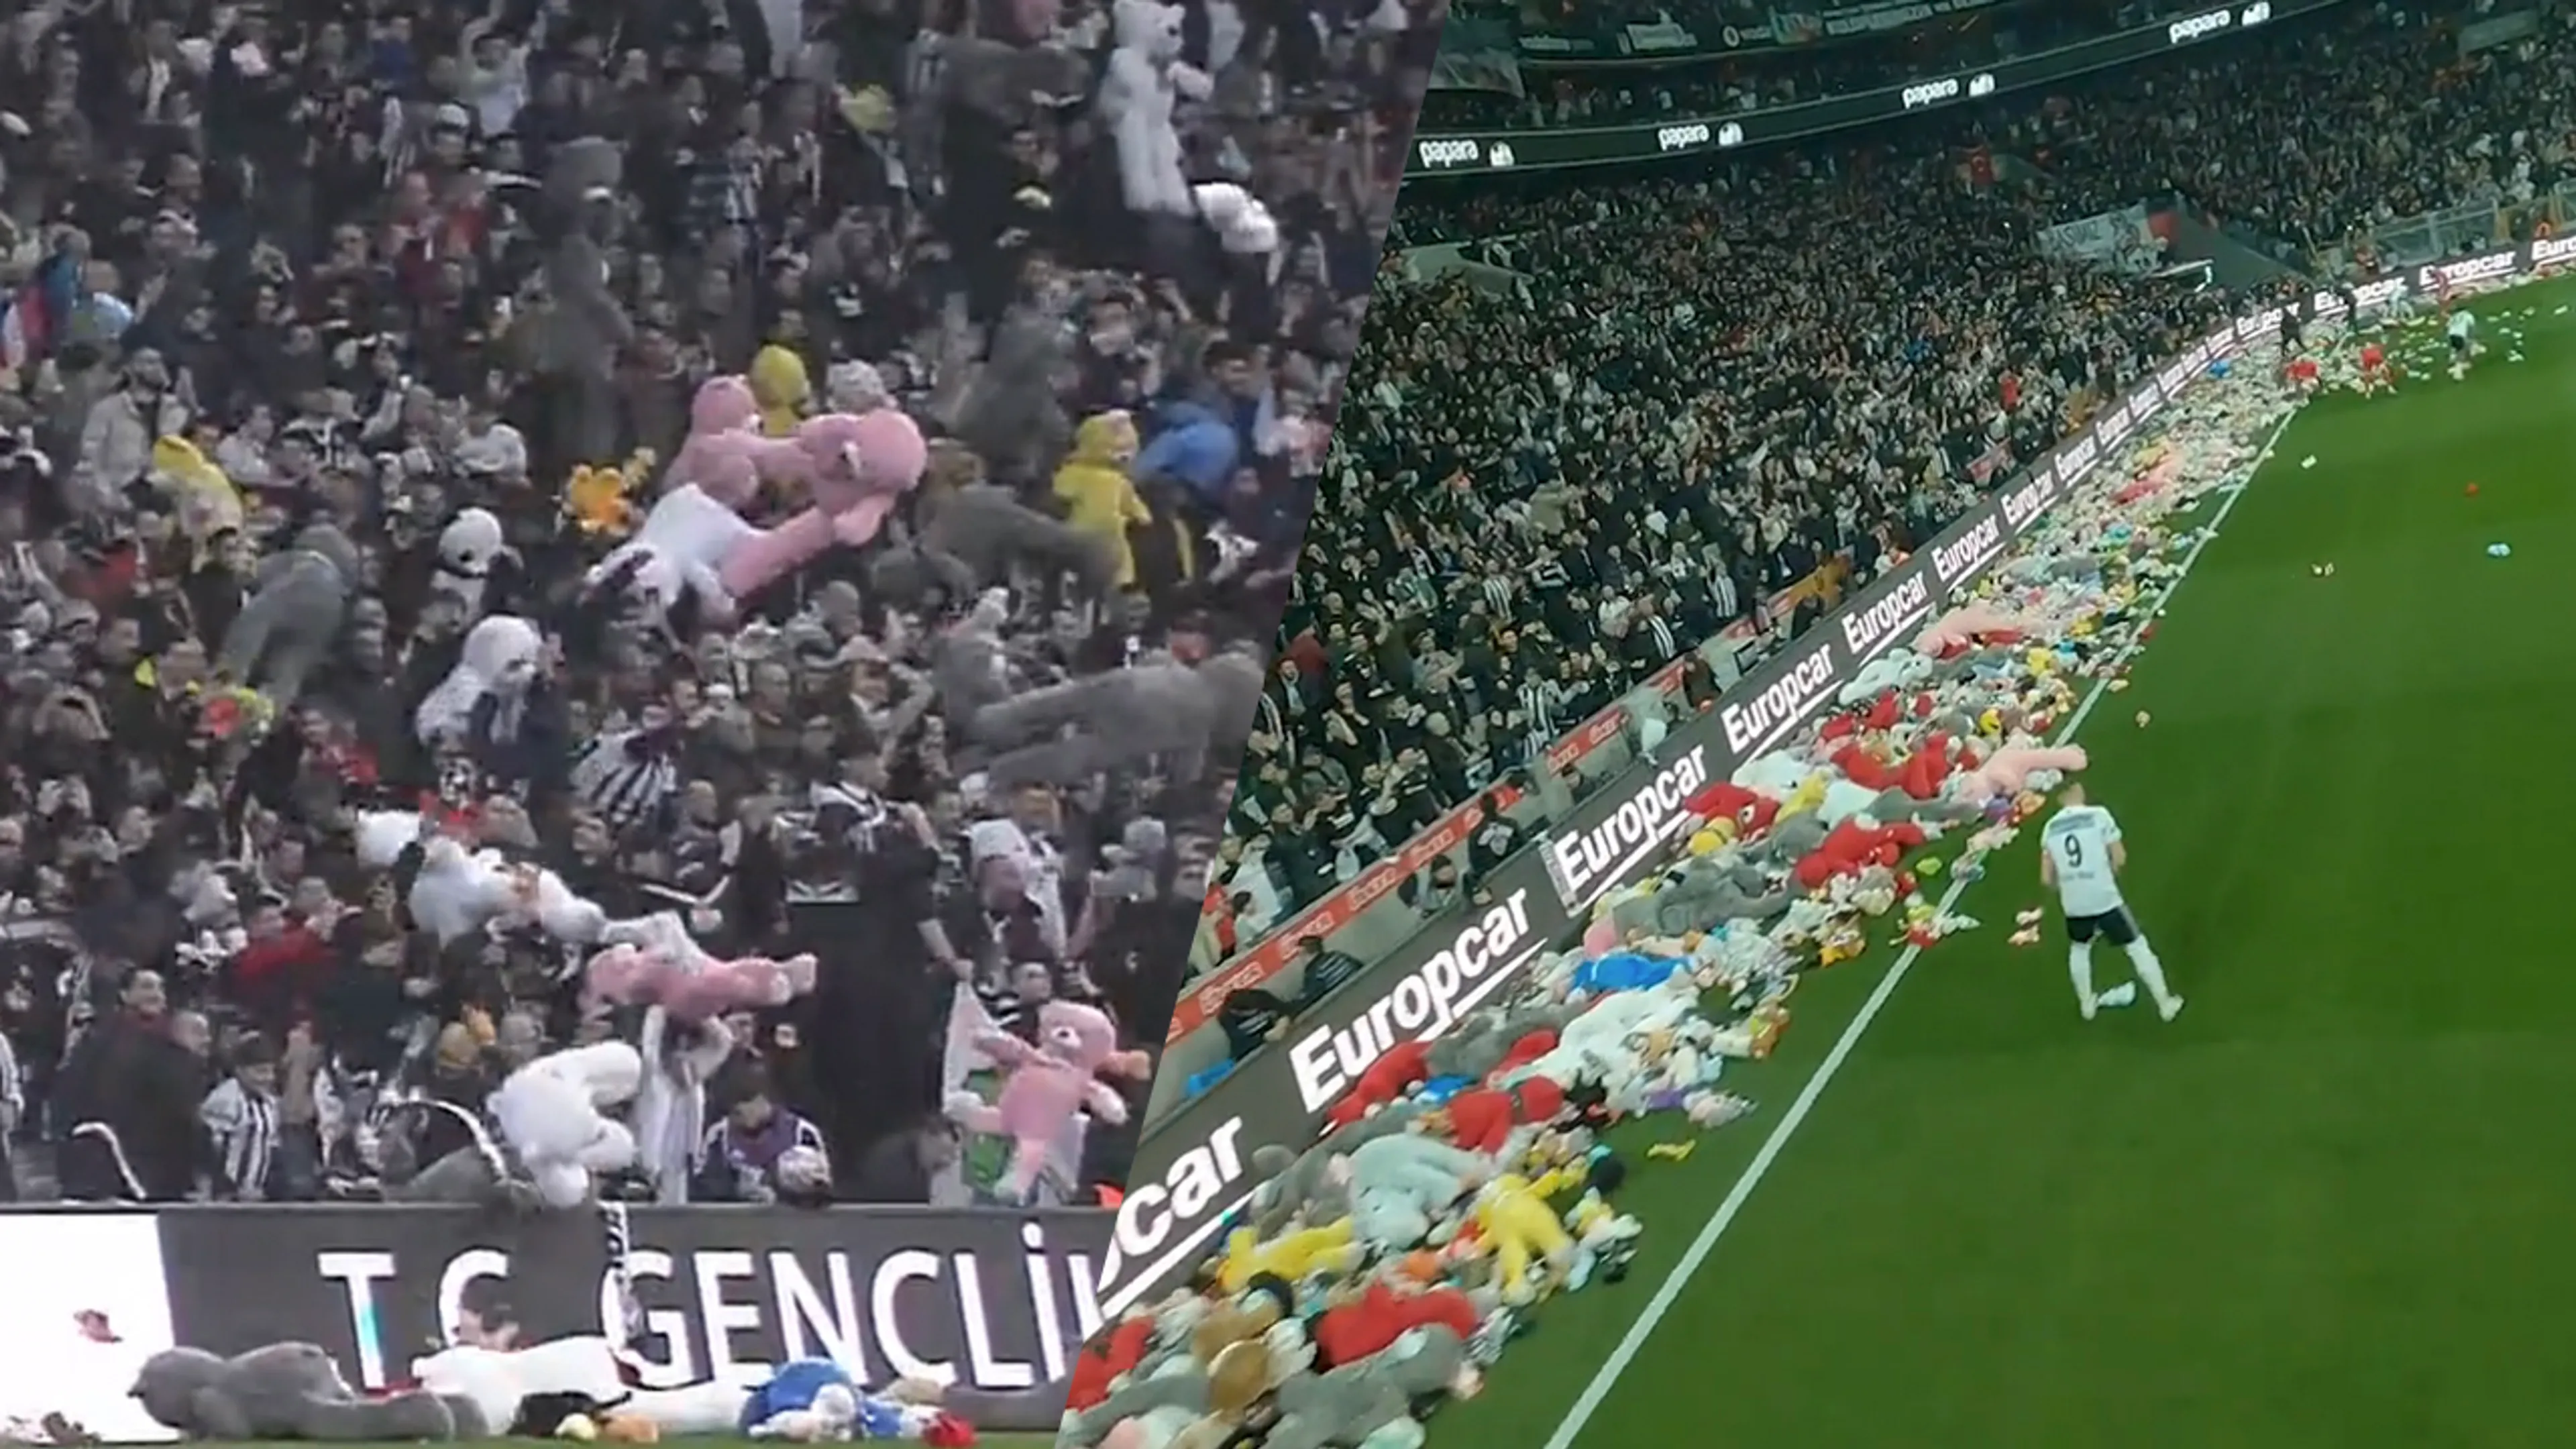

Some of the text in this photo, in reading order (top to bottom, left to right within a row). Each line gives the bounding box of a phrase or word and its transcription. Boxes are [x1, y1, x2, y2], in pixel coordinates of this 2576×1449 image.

[2169, 9, 2231, 44] papara
[1902, 78, 1959, 109] papara
[1419, 139, 1479, 168] papara
[1658, 123, 1710, 151] papara
[1931, 515, 2000, 582] Europcar
[1841, 571, 1928, 654] Europcar
[1721, 643, 1835, 755] Europcar
[1554, 744, 1709, 891] Europcar
[2064, 833, 2083, 868] 9
[1289, 888, 1532, 1113] Europcar
[1097, 1116, 1242, 1293] car
